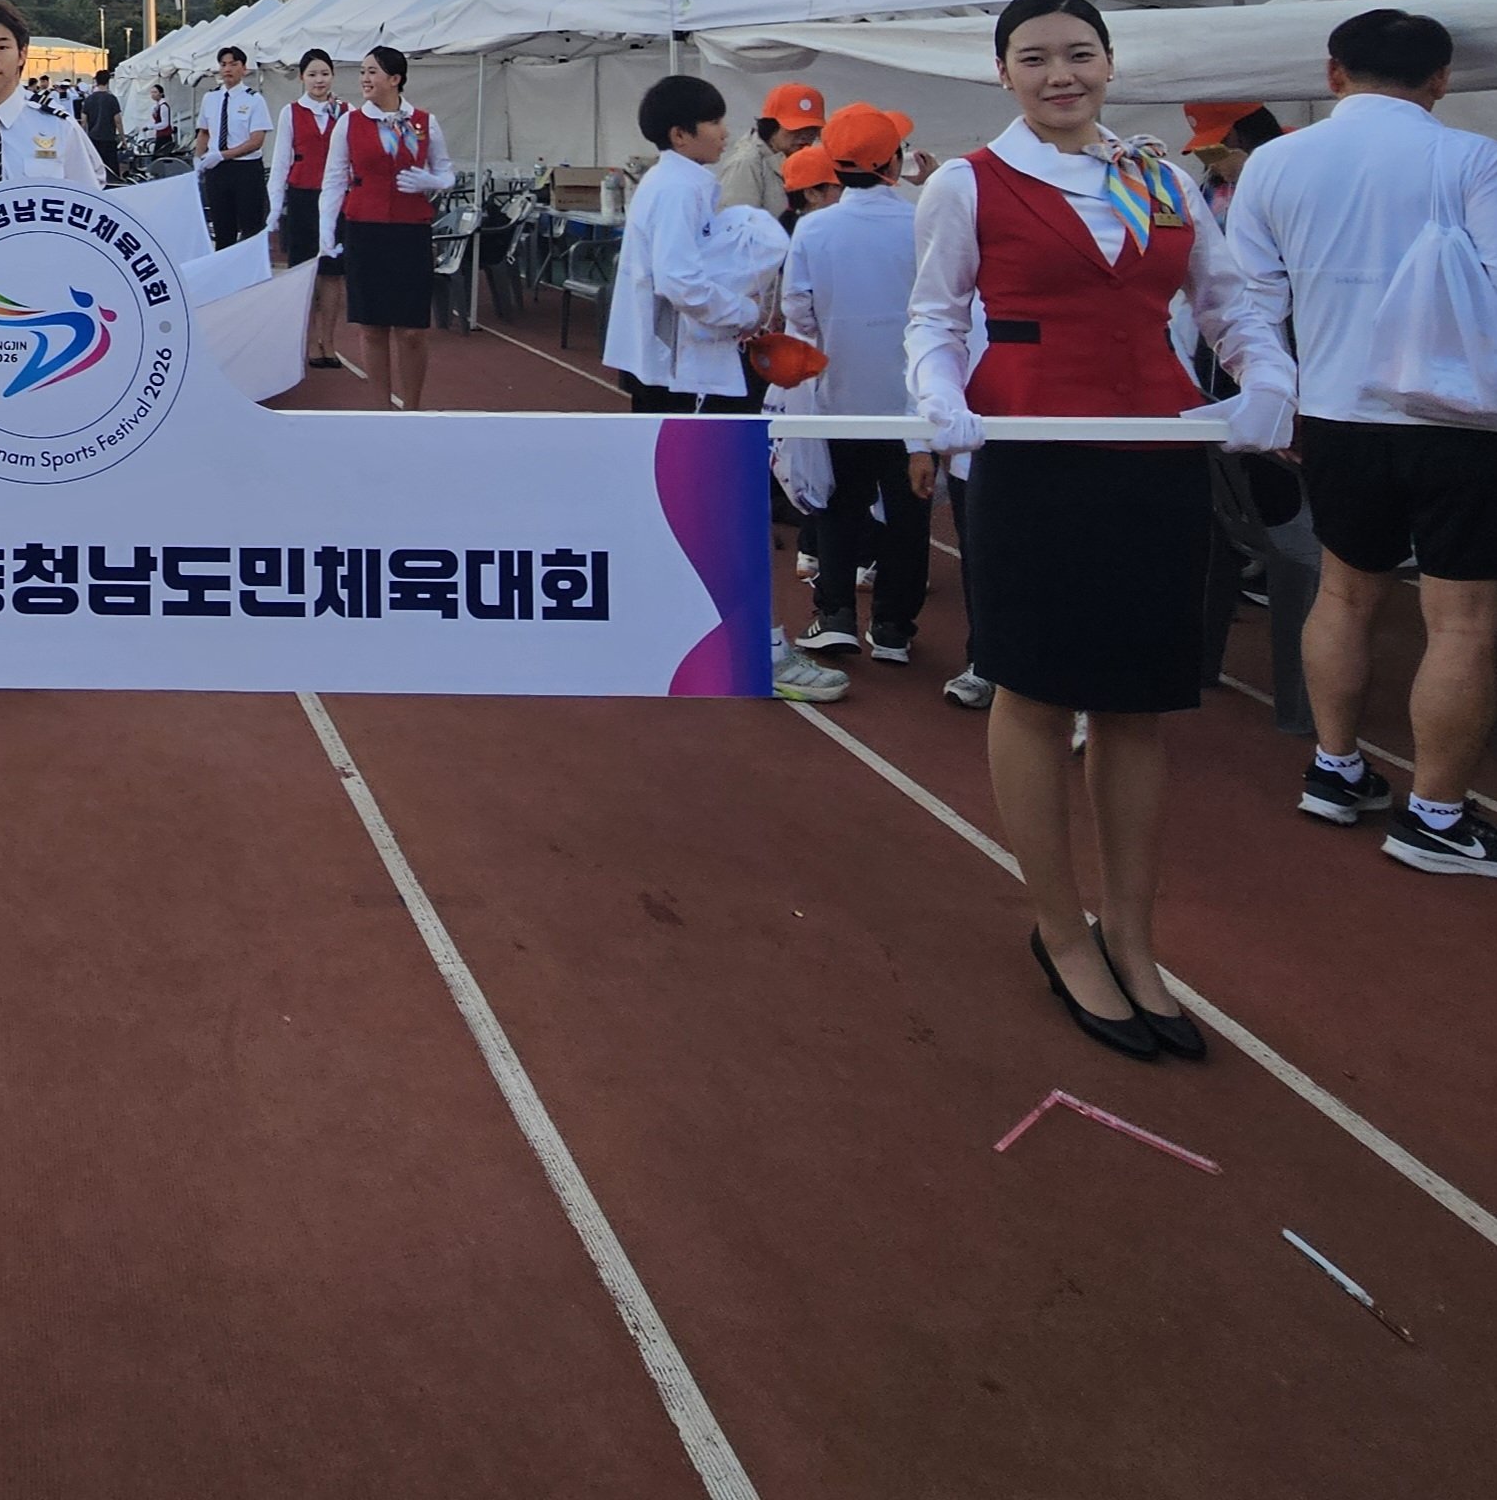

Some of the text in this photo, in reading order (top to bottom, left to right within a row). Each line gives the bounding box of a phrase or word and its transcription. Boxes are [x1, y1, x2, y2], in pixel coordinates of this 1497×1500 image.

[40, 445, 97, 472] Sports
[96, 397, 152, 451] Festival
[143, 347, 173, 400] 2026
